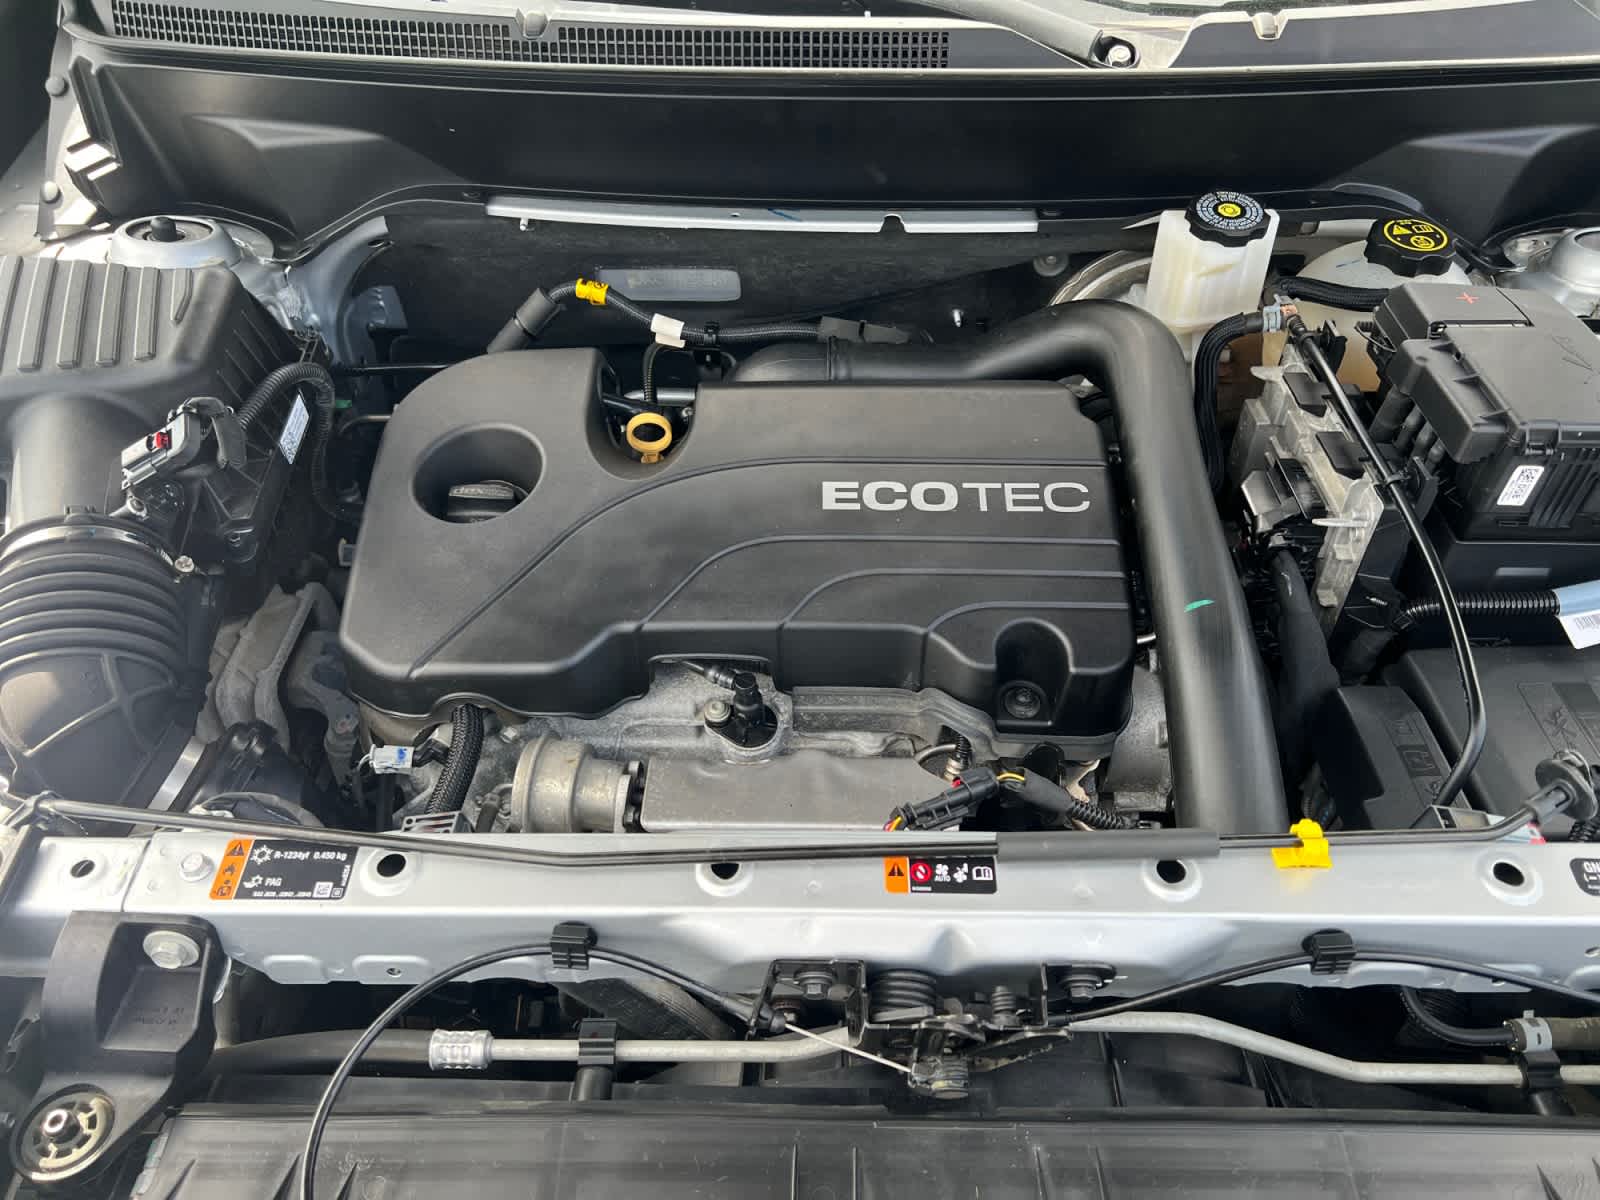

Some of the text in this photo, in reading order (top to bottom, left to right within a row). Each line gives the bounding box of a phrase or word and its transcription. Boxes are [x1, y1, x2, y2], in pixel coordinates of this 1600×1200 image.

[822, 481, 1090, 512] ECOTEC
[274, 851, 347, 860] R-1234yf 0.450 kg
[265, 878, 282, 887] PAG
